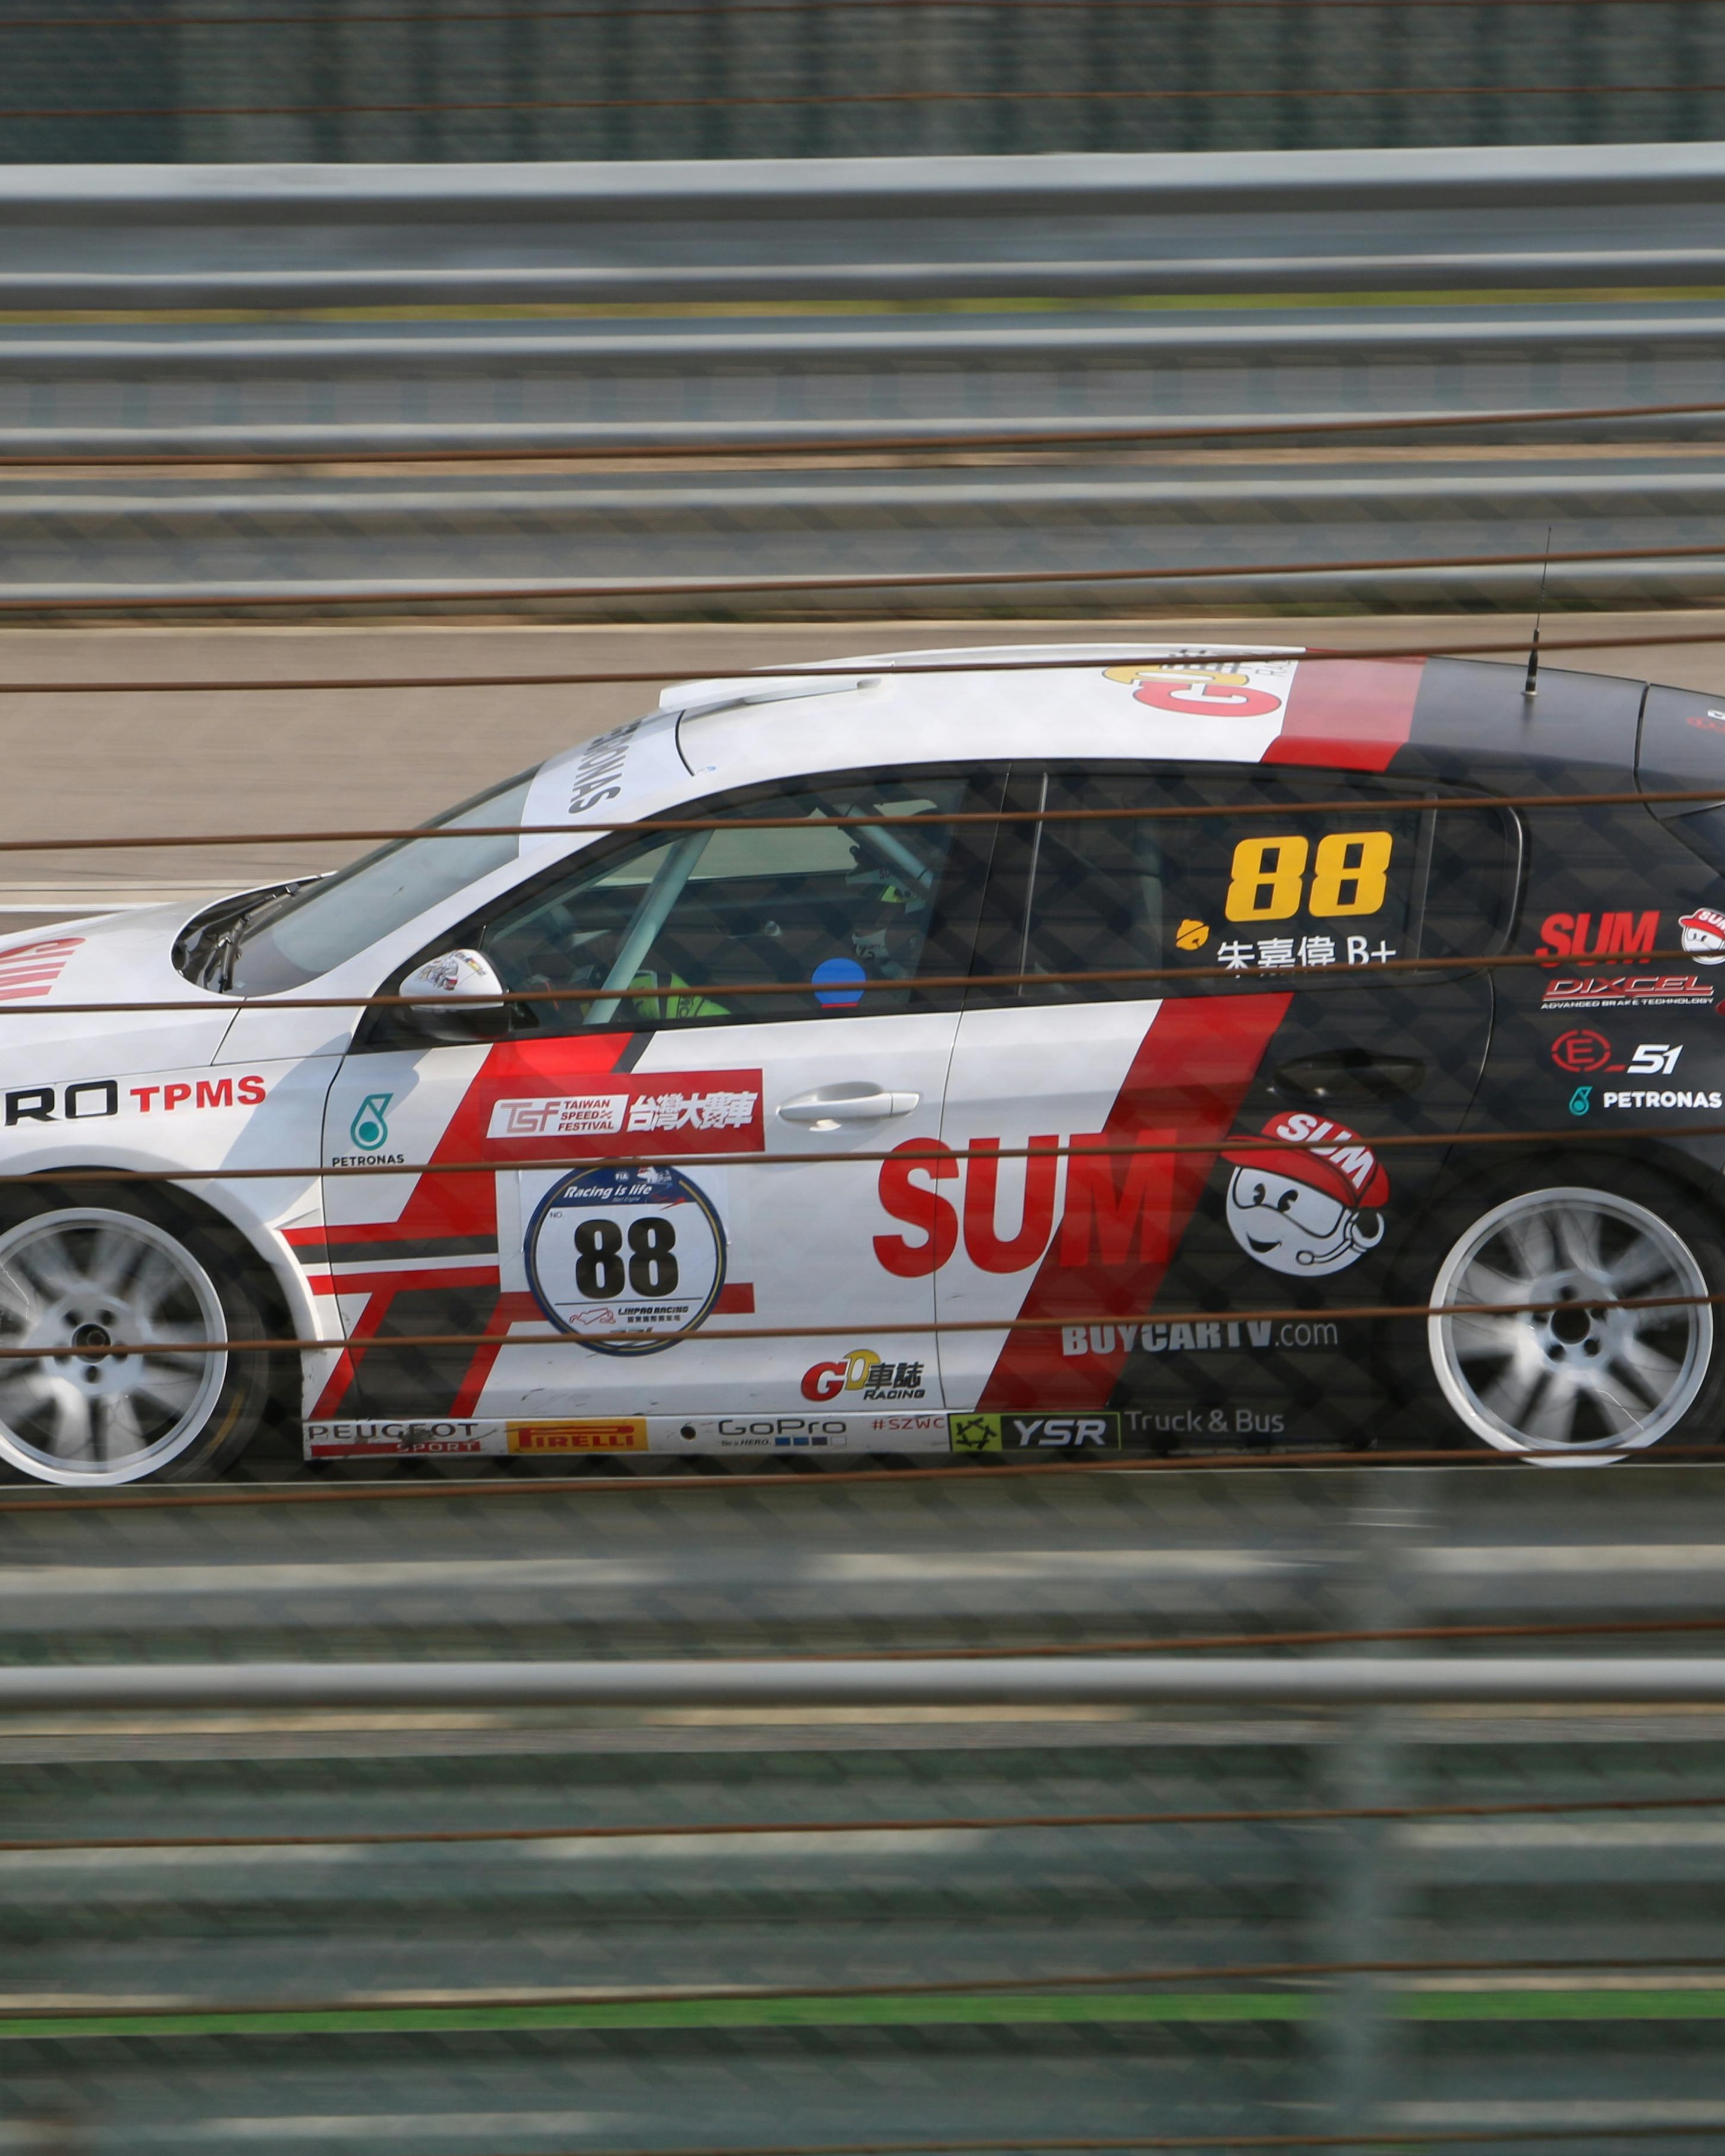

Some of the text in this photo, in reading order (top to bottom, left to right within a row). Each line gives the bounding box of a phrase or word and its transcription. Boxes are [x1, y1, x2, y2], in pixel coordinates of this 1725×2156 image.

[1225, 830, 1393, 922] 88
[1535, 910, 1660, 968] SUM
[1346, 935, 1397, 965] B+
[1542, 975, 1714, 1000] DIXCEL
[1540, 997, 1714, 1010] ADVANCED BRAKE TECHNOLOGY
[1627, 1044, 1684, 1074] 51
[130, 1075, 266, 1113] TPMS
[1603, 1091, 1723, 1108] PETRONAS
[564, 1099, 611, 1110] TAIWAN
[560, 1110, 599, 1121] SPEED
[558, 1121, 615, 1132] FESTIVAL
[332, 1154, 405, 1167] PETRONAS
[1276, 1113, 1375, 1190] SUM
[563, 1184, 652, 1199] Racing is life
[873, 1128, 1178, 1278] SUM
[574, 1217, 679, 1300] 88
[654, 1305, 689, 1314] RACING
[865, 1361, 925, 1390] 車誌
[863, 1389, 926, 1401] RACING
[718, 1419, 847, 1436] GoPro
[871, 1417, 947, 1430] #SZWC
[1013, 1410, 1285, 1446] YSR Truck & Bus
[518, 1426, 635, 1448] PIRELLI
[397, 1442, 476, 1453] SPORT
